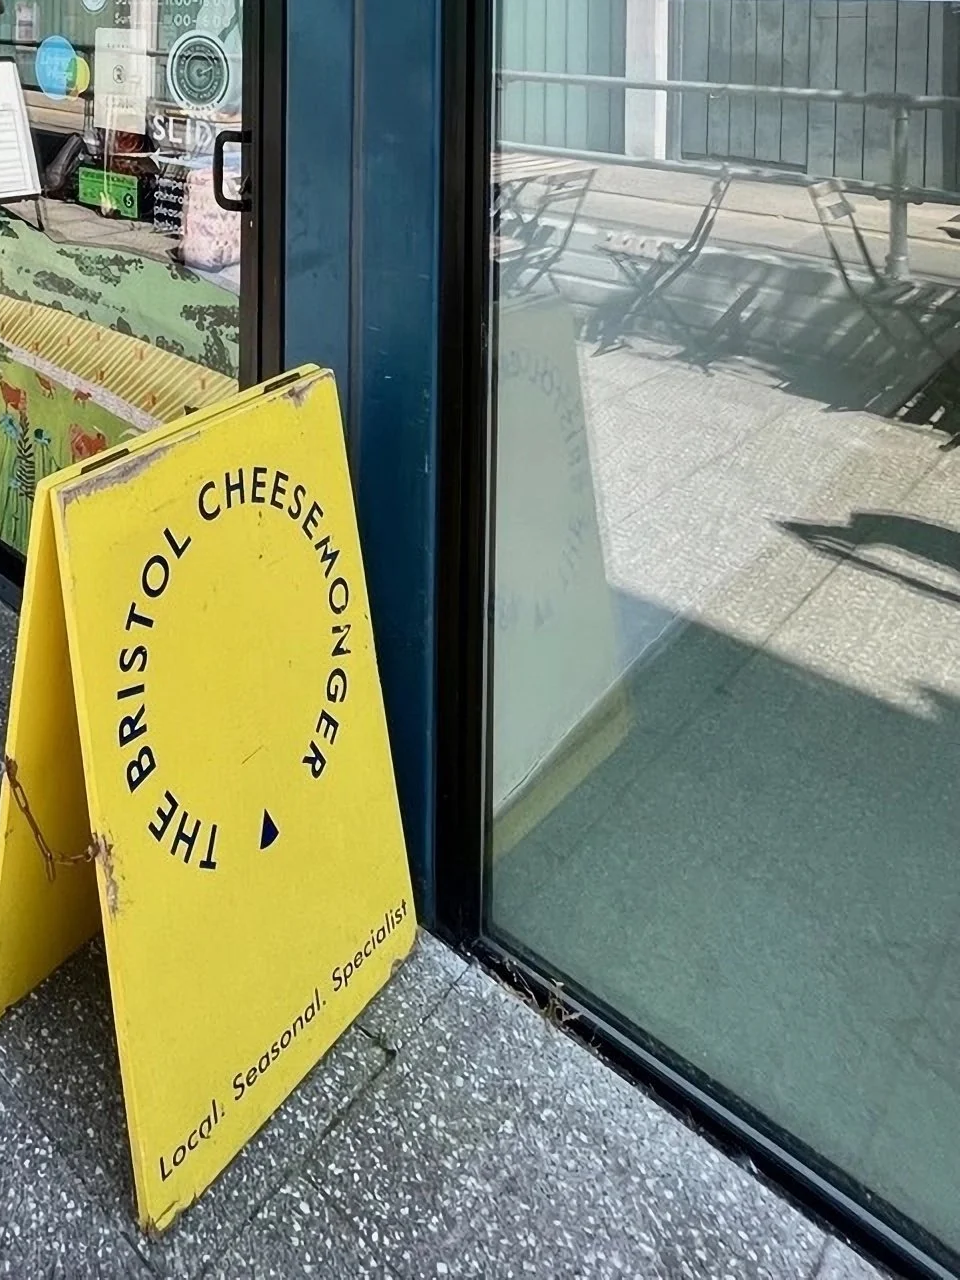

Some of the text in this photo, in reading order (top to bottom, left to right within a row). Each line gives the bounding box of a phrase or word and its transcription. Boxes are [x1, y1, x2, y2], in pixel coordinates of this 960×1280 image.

[116, 466, 352, 870] THE BRISTOL CHEESEMONGER
[159, 898, 408, 1182] Local. Seasonal. Specialist
